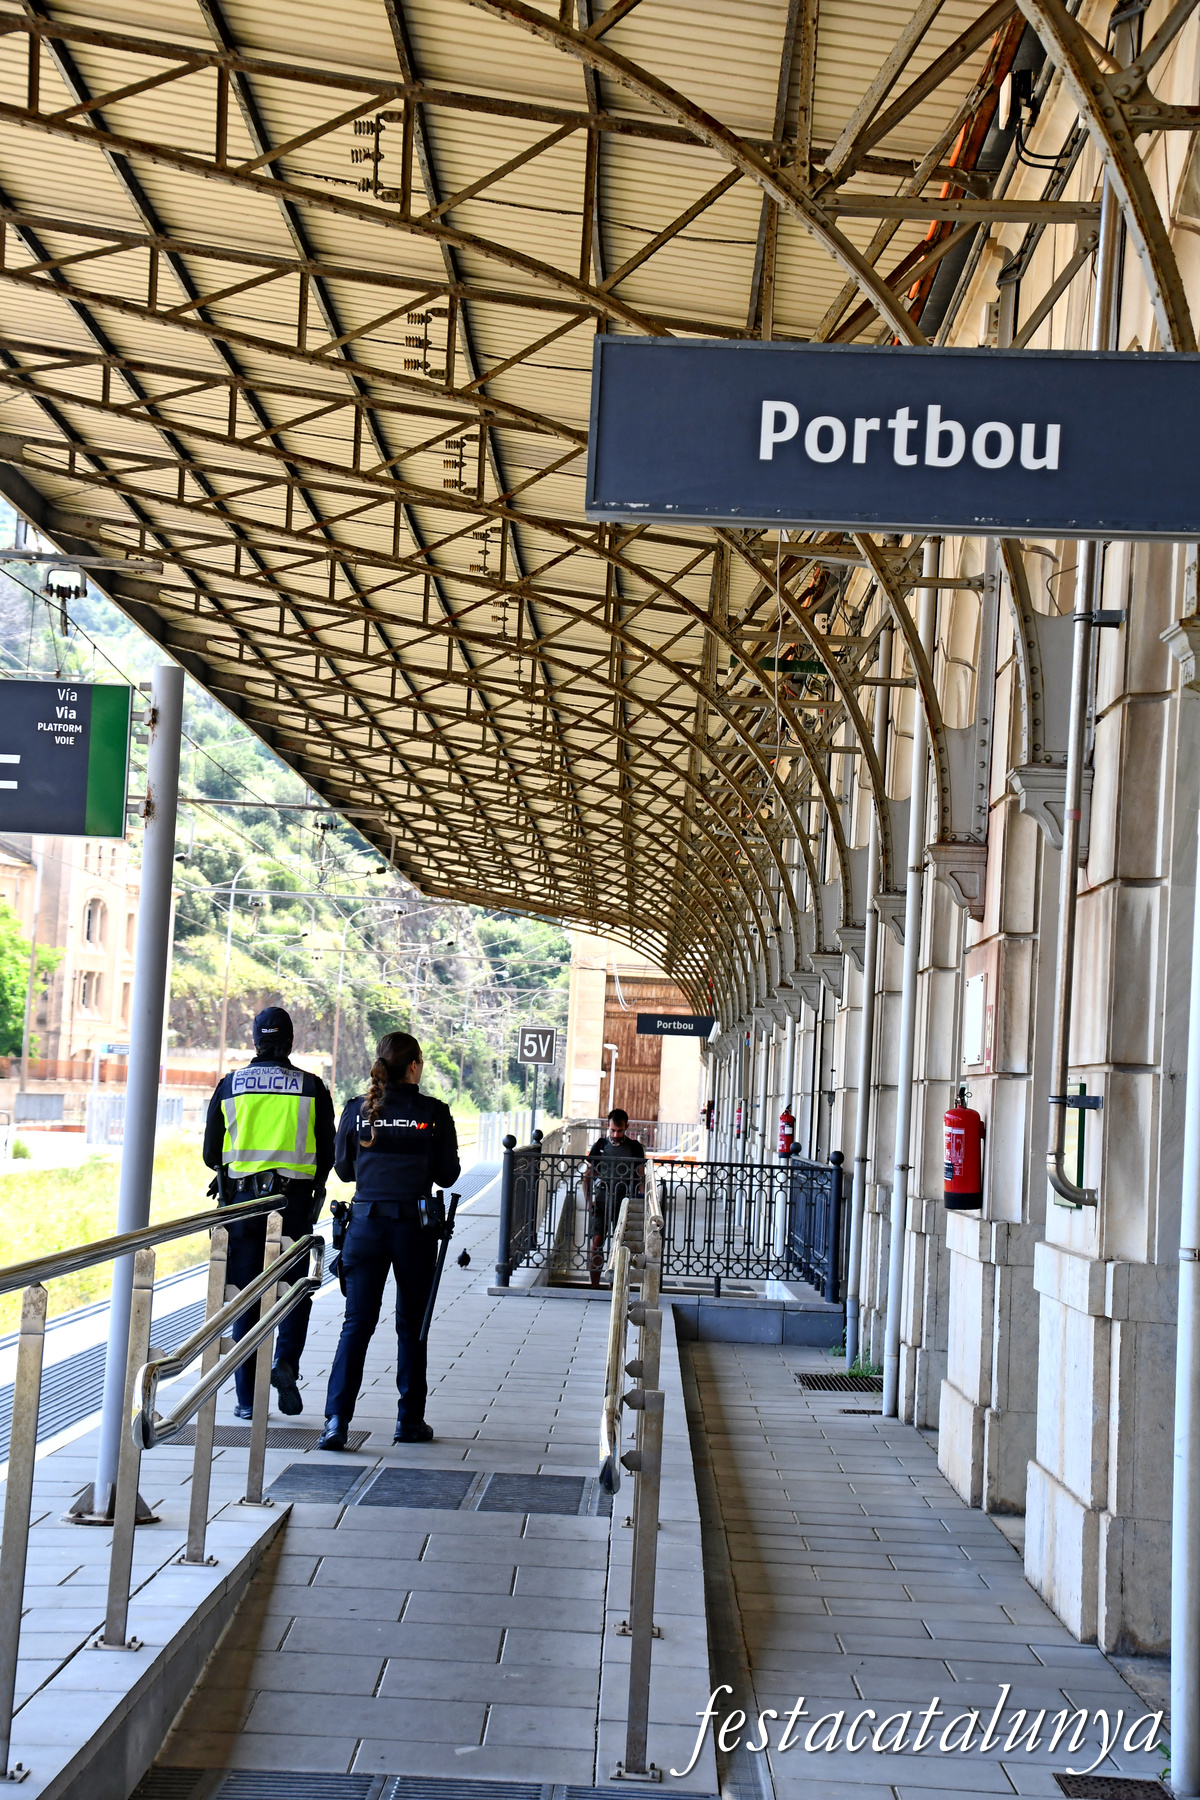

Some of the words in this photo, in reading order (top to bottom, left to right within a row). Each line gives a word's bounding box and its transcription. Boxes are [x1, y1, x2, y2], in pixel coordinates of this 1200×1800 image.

[759, 400, 1061, 471] Portbou
[57, 687, 78, 702] Vía
[55, 706, 77, 719] Via
[37, 722, 82, 733] PLATFORM
[54, 735, 75, 745] VOIE
[656, 1020, 694, 1031] Portbou
[523, 1033, 551, 1058] 5V
[236, 1068, 261, 1077] CUERPO
[234, 1076, 299, 1090] POLICIA
